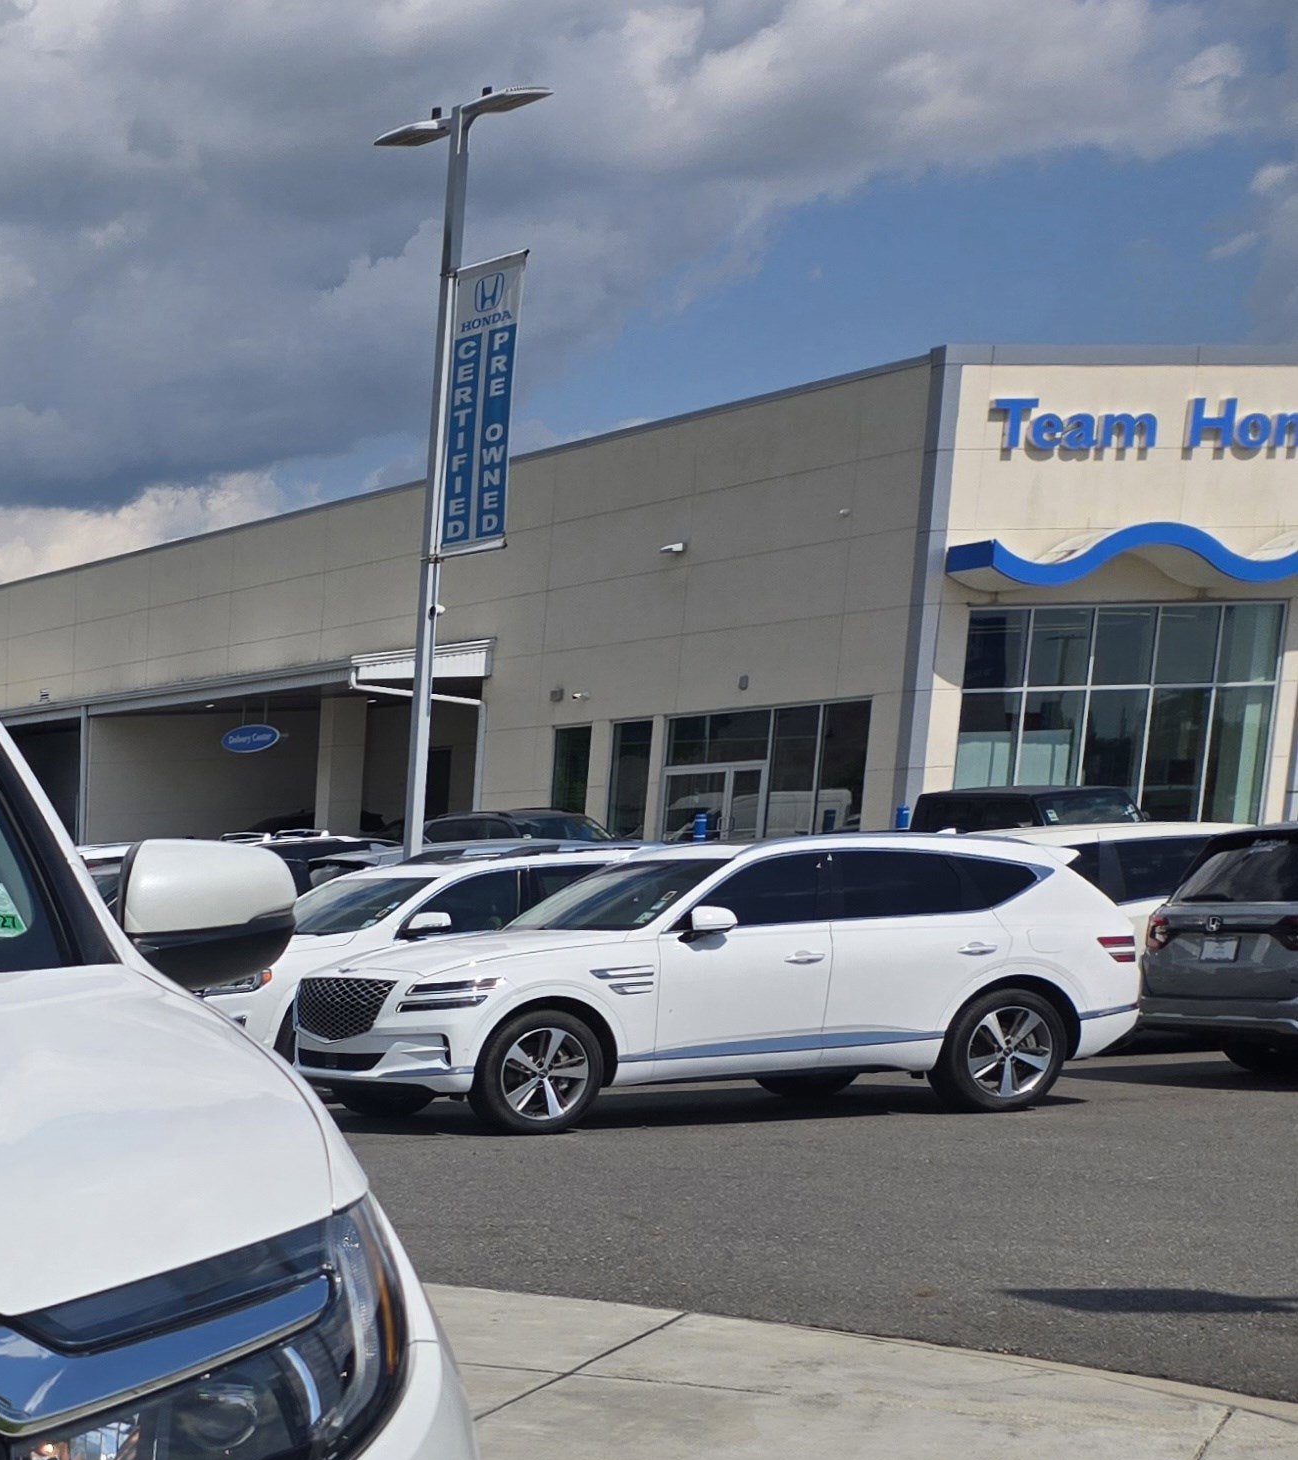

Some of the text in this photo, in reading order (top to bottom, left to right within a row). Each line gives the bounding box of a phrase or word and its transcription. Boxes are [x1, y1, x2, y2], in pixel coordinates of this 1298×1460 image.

[460, 310, 512, 332] HONDA
[447, 341, 477, 538] CERTIFIED
[482, 331, 510, 532] PRE OWNED
[994, 397, 1158, 450] Team
